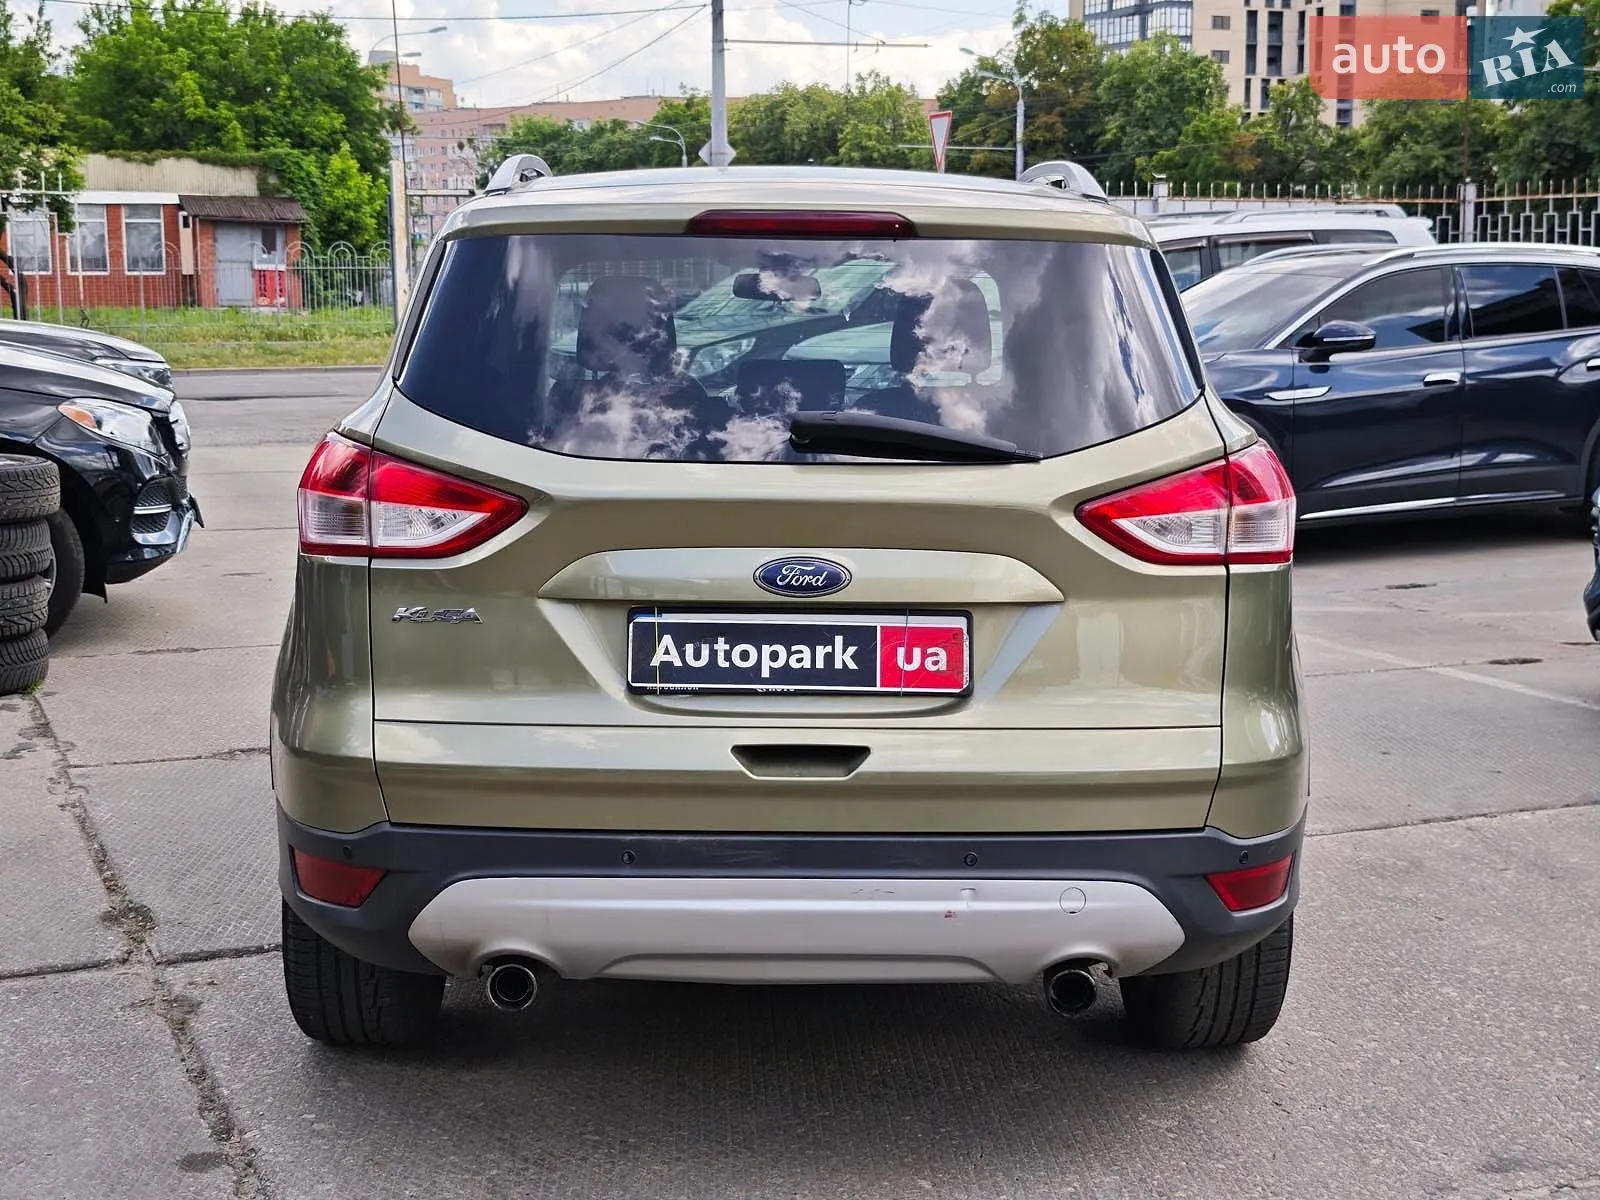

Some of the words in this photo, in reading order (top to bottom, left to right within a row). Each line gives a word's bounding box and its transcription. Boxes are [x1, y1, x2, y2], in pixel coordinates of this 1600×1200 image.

[776, 564, 828, 587] Ford
[650, 634, 859, 678] Autopark
[896, 646, 949, 672] ua
